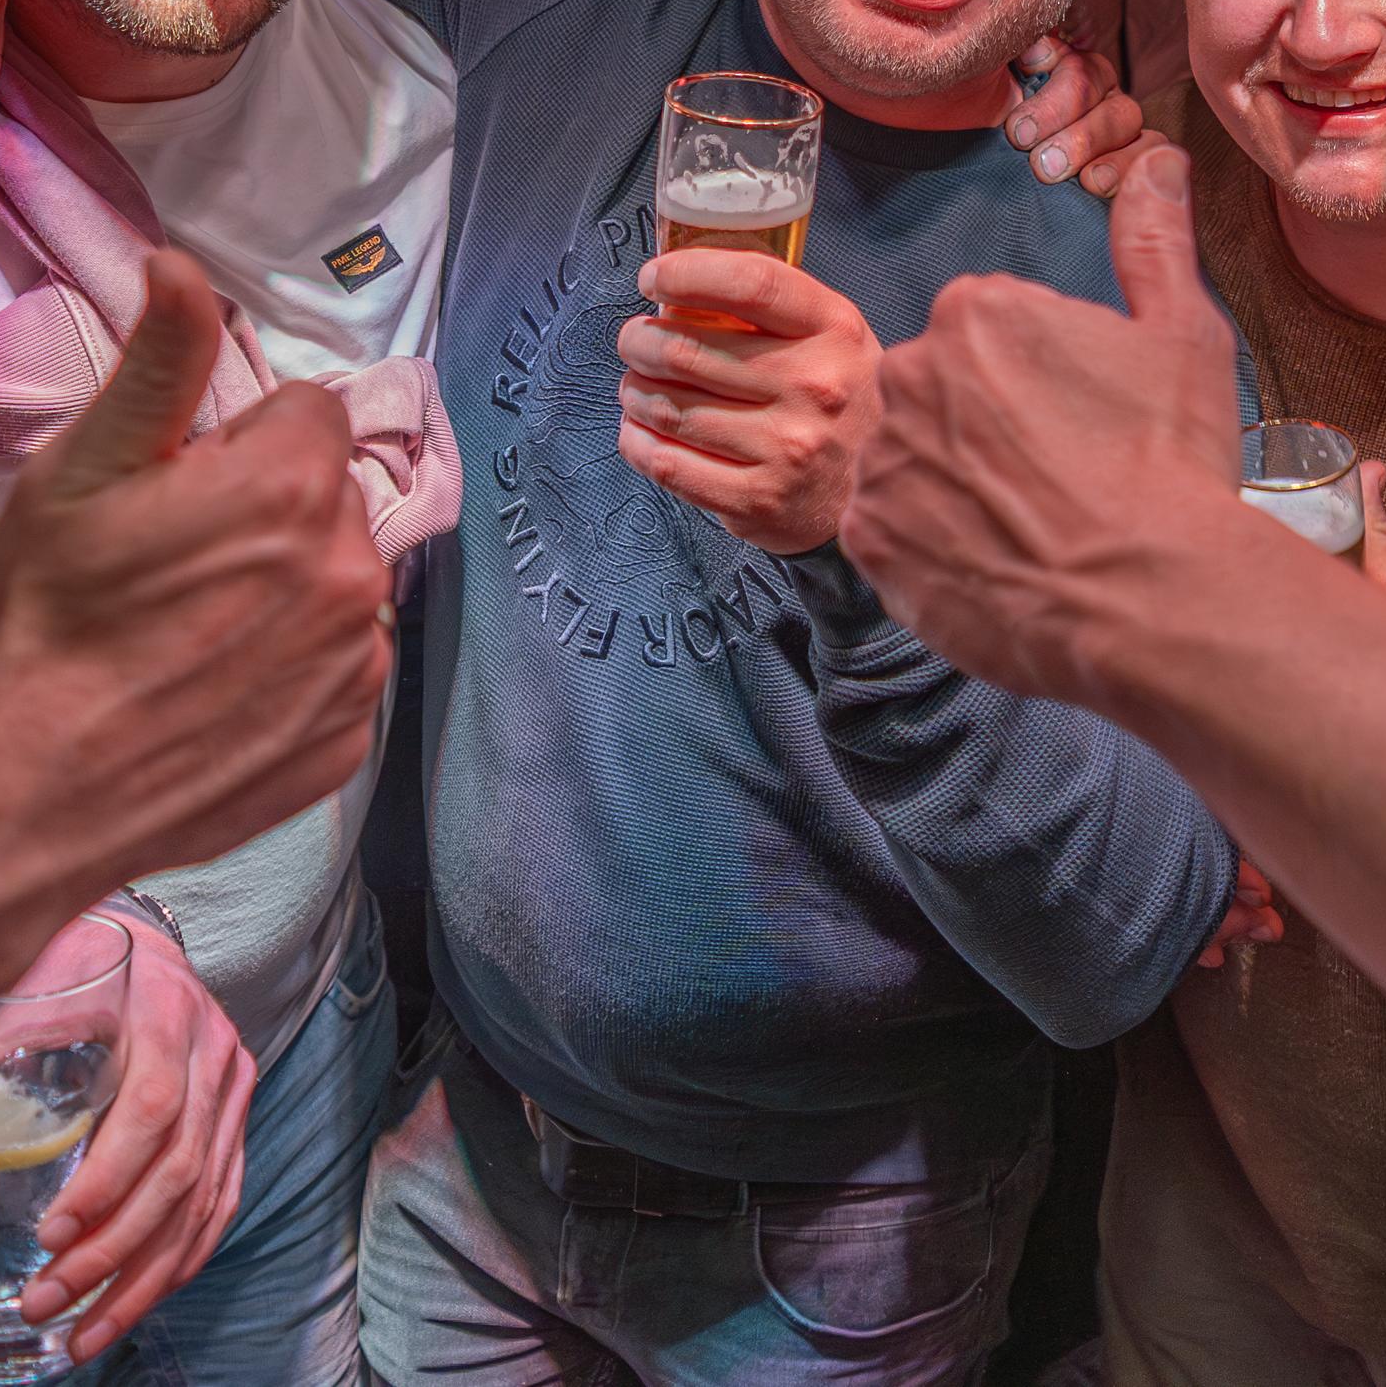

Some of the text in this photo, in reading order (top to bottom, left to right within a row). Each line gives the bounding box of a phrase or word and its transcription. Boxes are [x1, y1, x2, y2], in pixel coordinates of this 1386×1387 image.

[331, 252, 353, 269] PME
[350, 235, 381, 258] LEGEND
[491, 247, 581, 414] RELIC
[493, 445, 620, 661] FLYING
